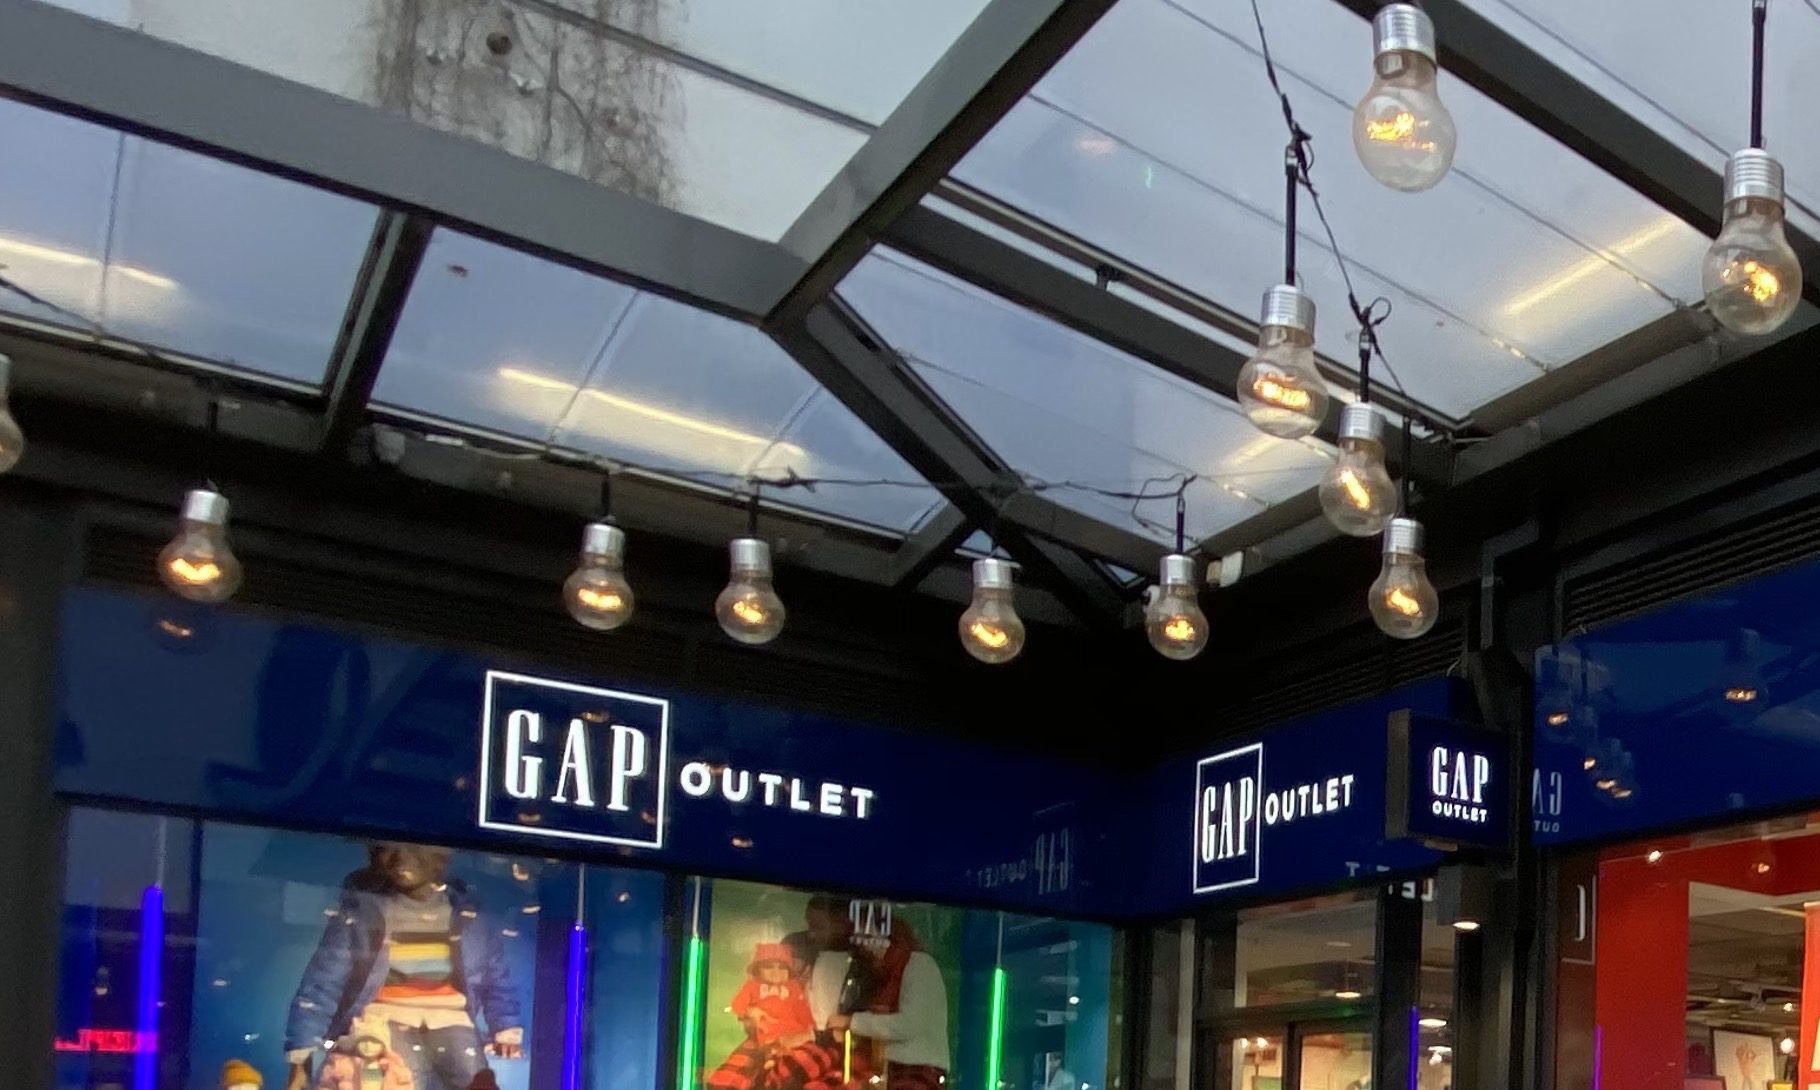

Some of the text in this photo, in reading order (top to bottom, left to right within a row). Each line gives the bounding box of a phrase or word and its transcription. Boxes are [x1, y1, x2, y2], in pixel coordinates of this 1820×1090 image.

[504, 709, 873, 818] GAP OUTLET
[1432, 746, 1489, 803] GAP
[1201, 774, 1354, 863] GAP OUTLET
[1432, 800, 1488, 823] OUTLET
